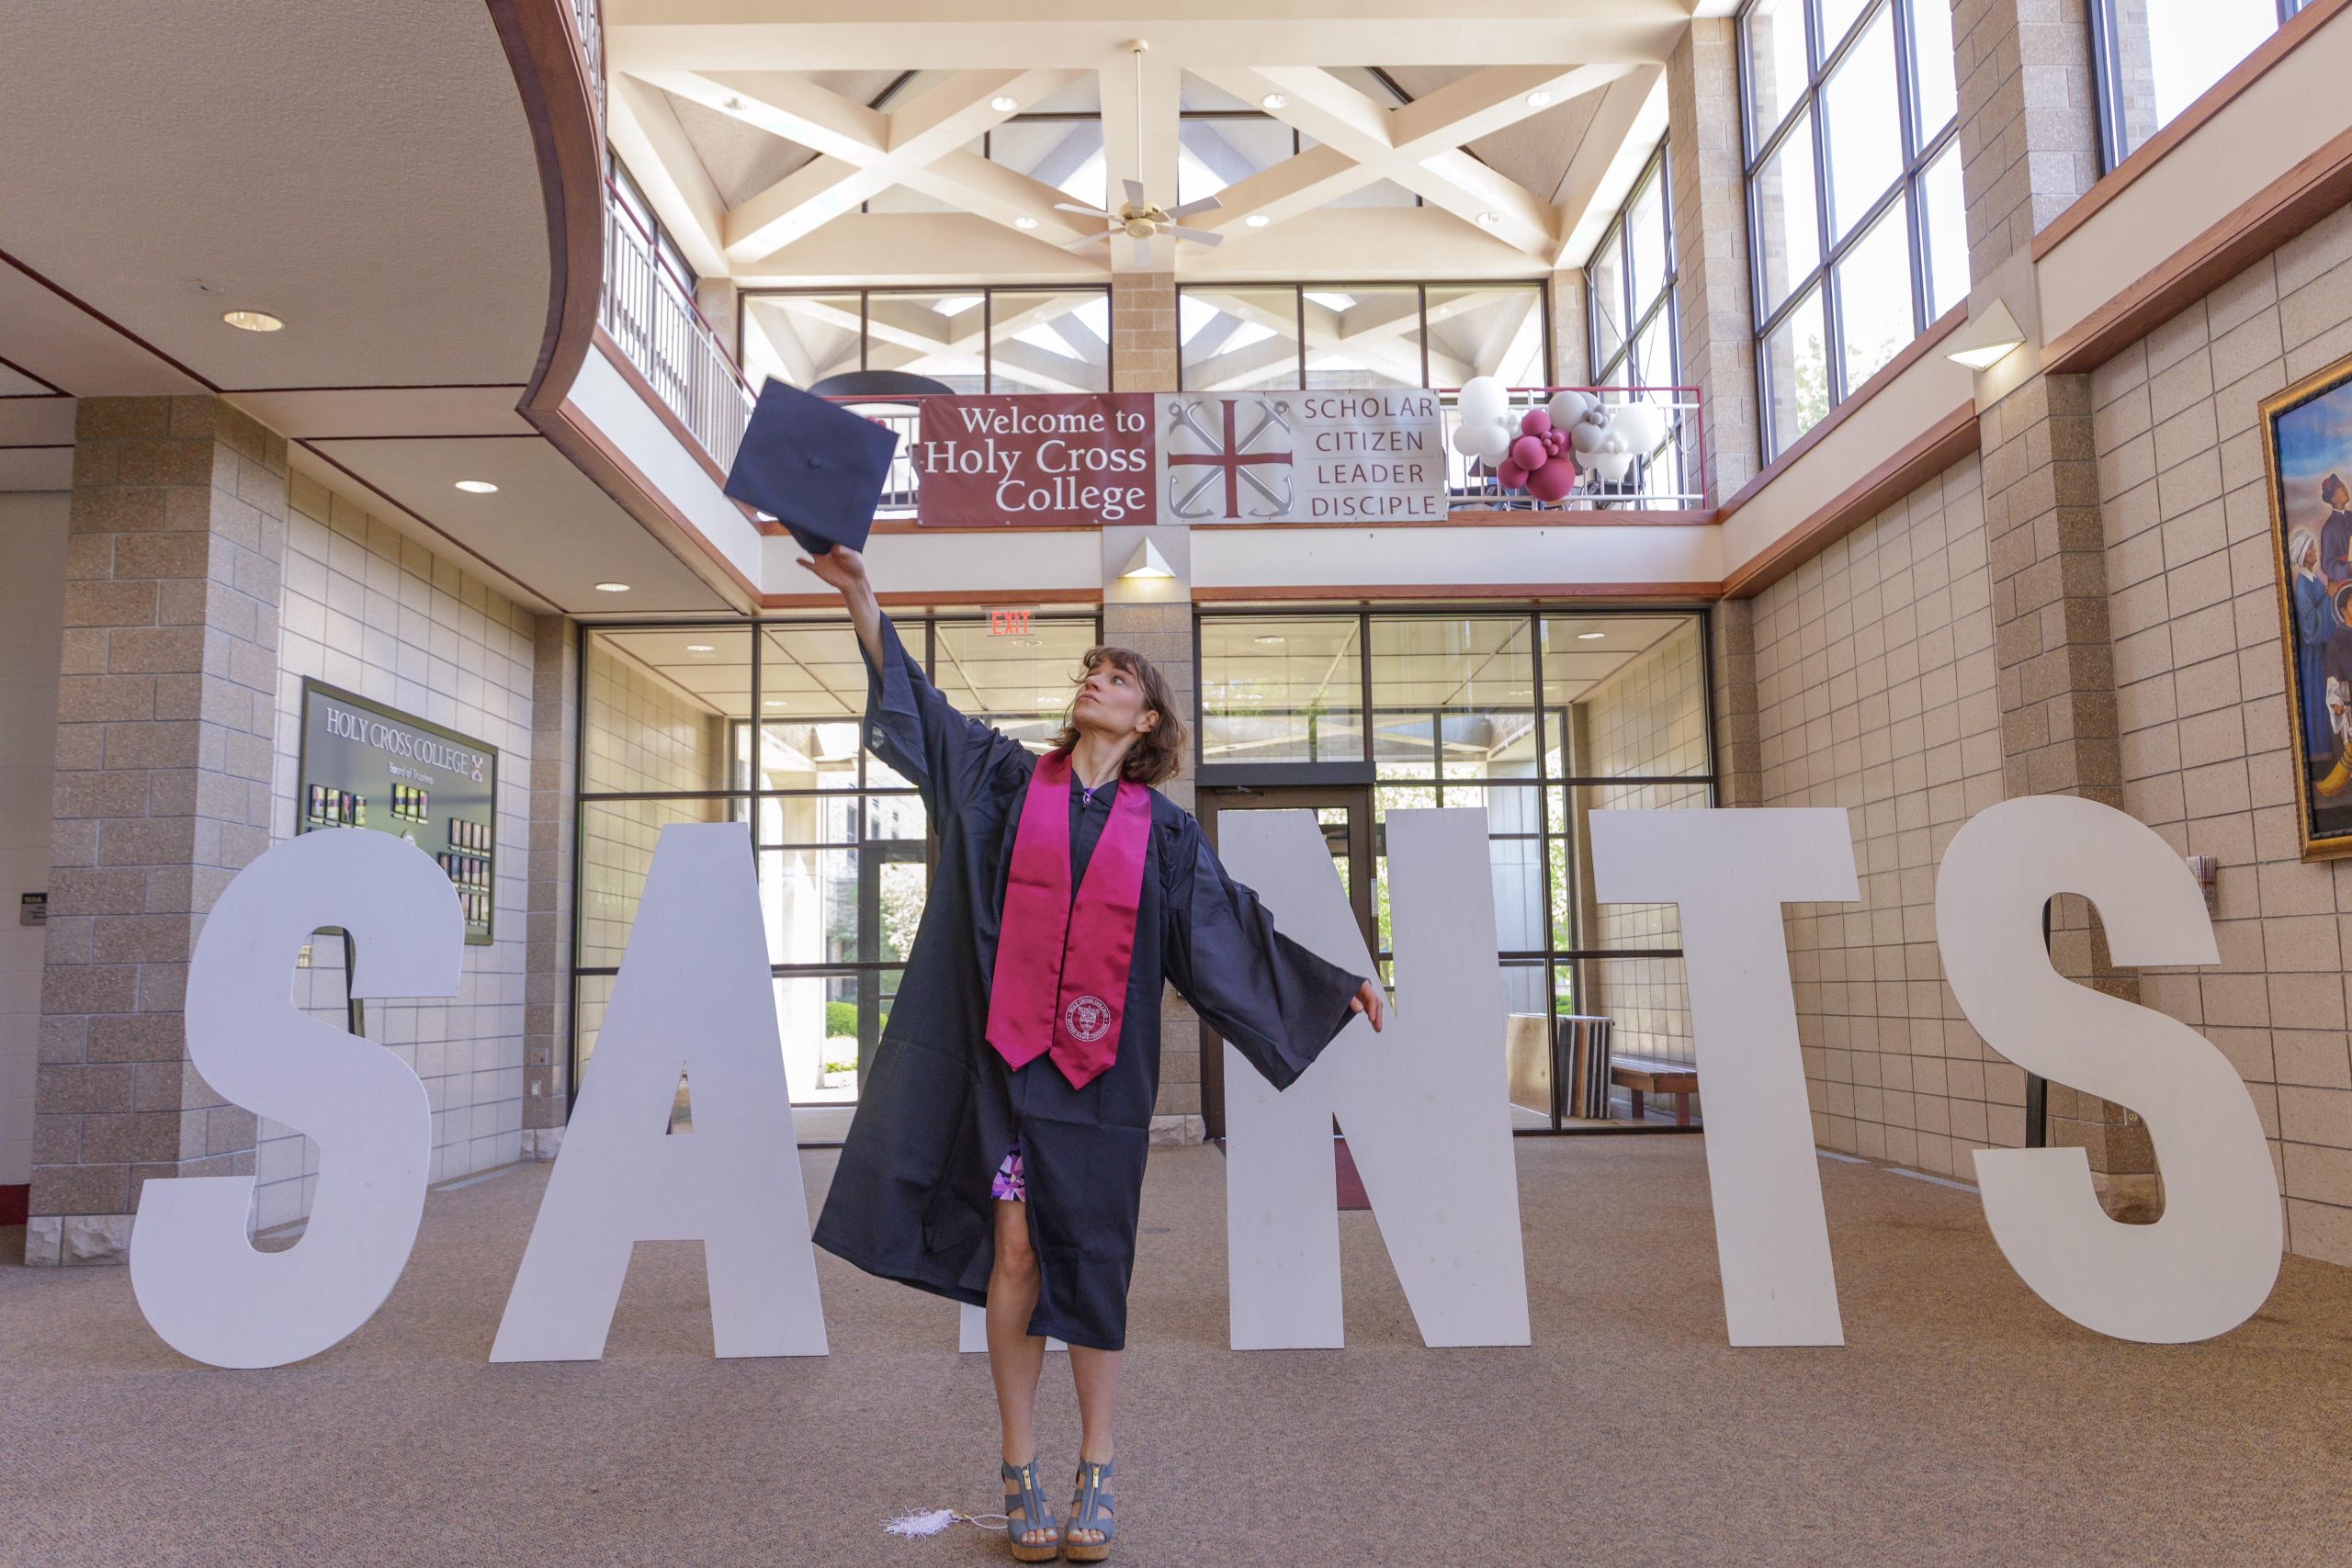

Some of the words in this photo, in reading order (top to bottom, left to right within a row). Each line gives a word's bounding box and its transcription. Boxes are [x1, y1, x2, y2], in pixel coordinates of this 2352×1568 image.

[958, 406, 1105, 434] Welcome
[1115, 410, 1146, 433] to
[1305, 397, 1433, 419] SCHOLAR
[1316, 431, 1423, 452] CITIZEN
[923, 438, 1022, 484] Holy
[1035, 439, 1148, 473] Cross
[1317, 463, 1424, 484] LEADER
[996, 476, 1147, 520] College
[1311, 495, 1437, 516] DISCIPLE
[991, 610, 1030, 635] EXIT
[326, 707, 368, 743] HOLY
[369, 723, 413, 758] CROSS
[413, 738, 469, 775] COLLEGE
[130, 794, 2284, 1371] SANTS
